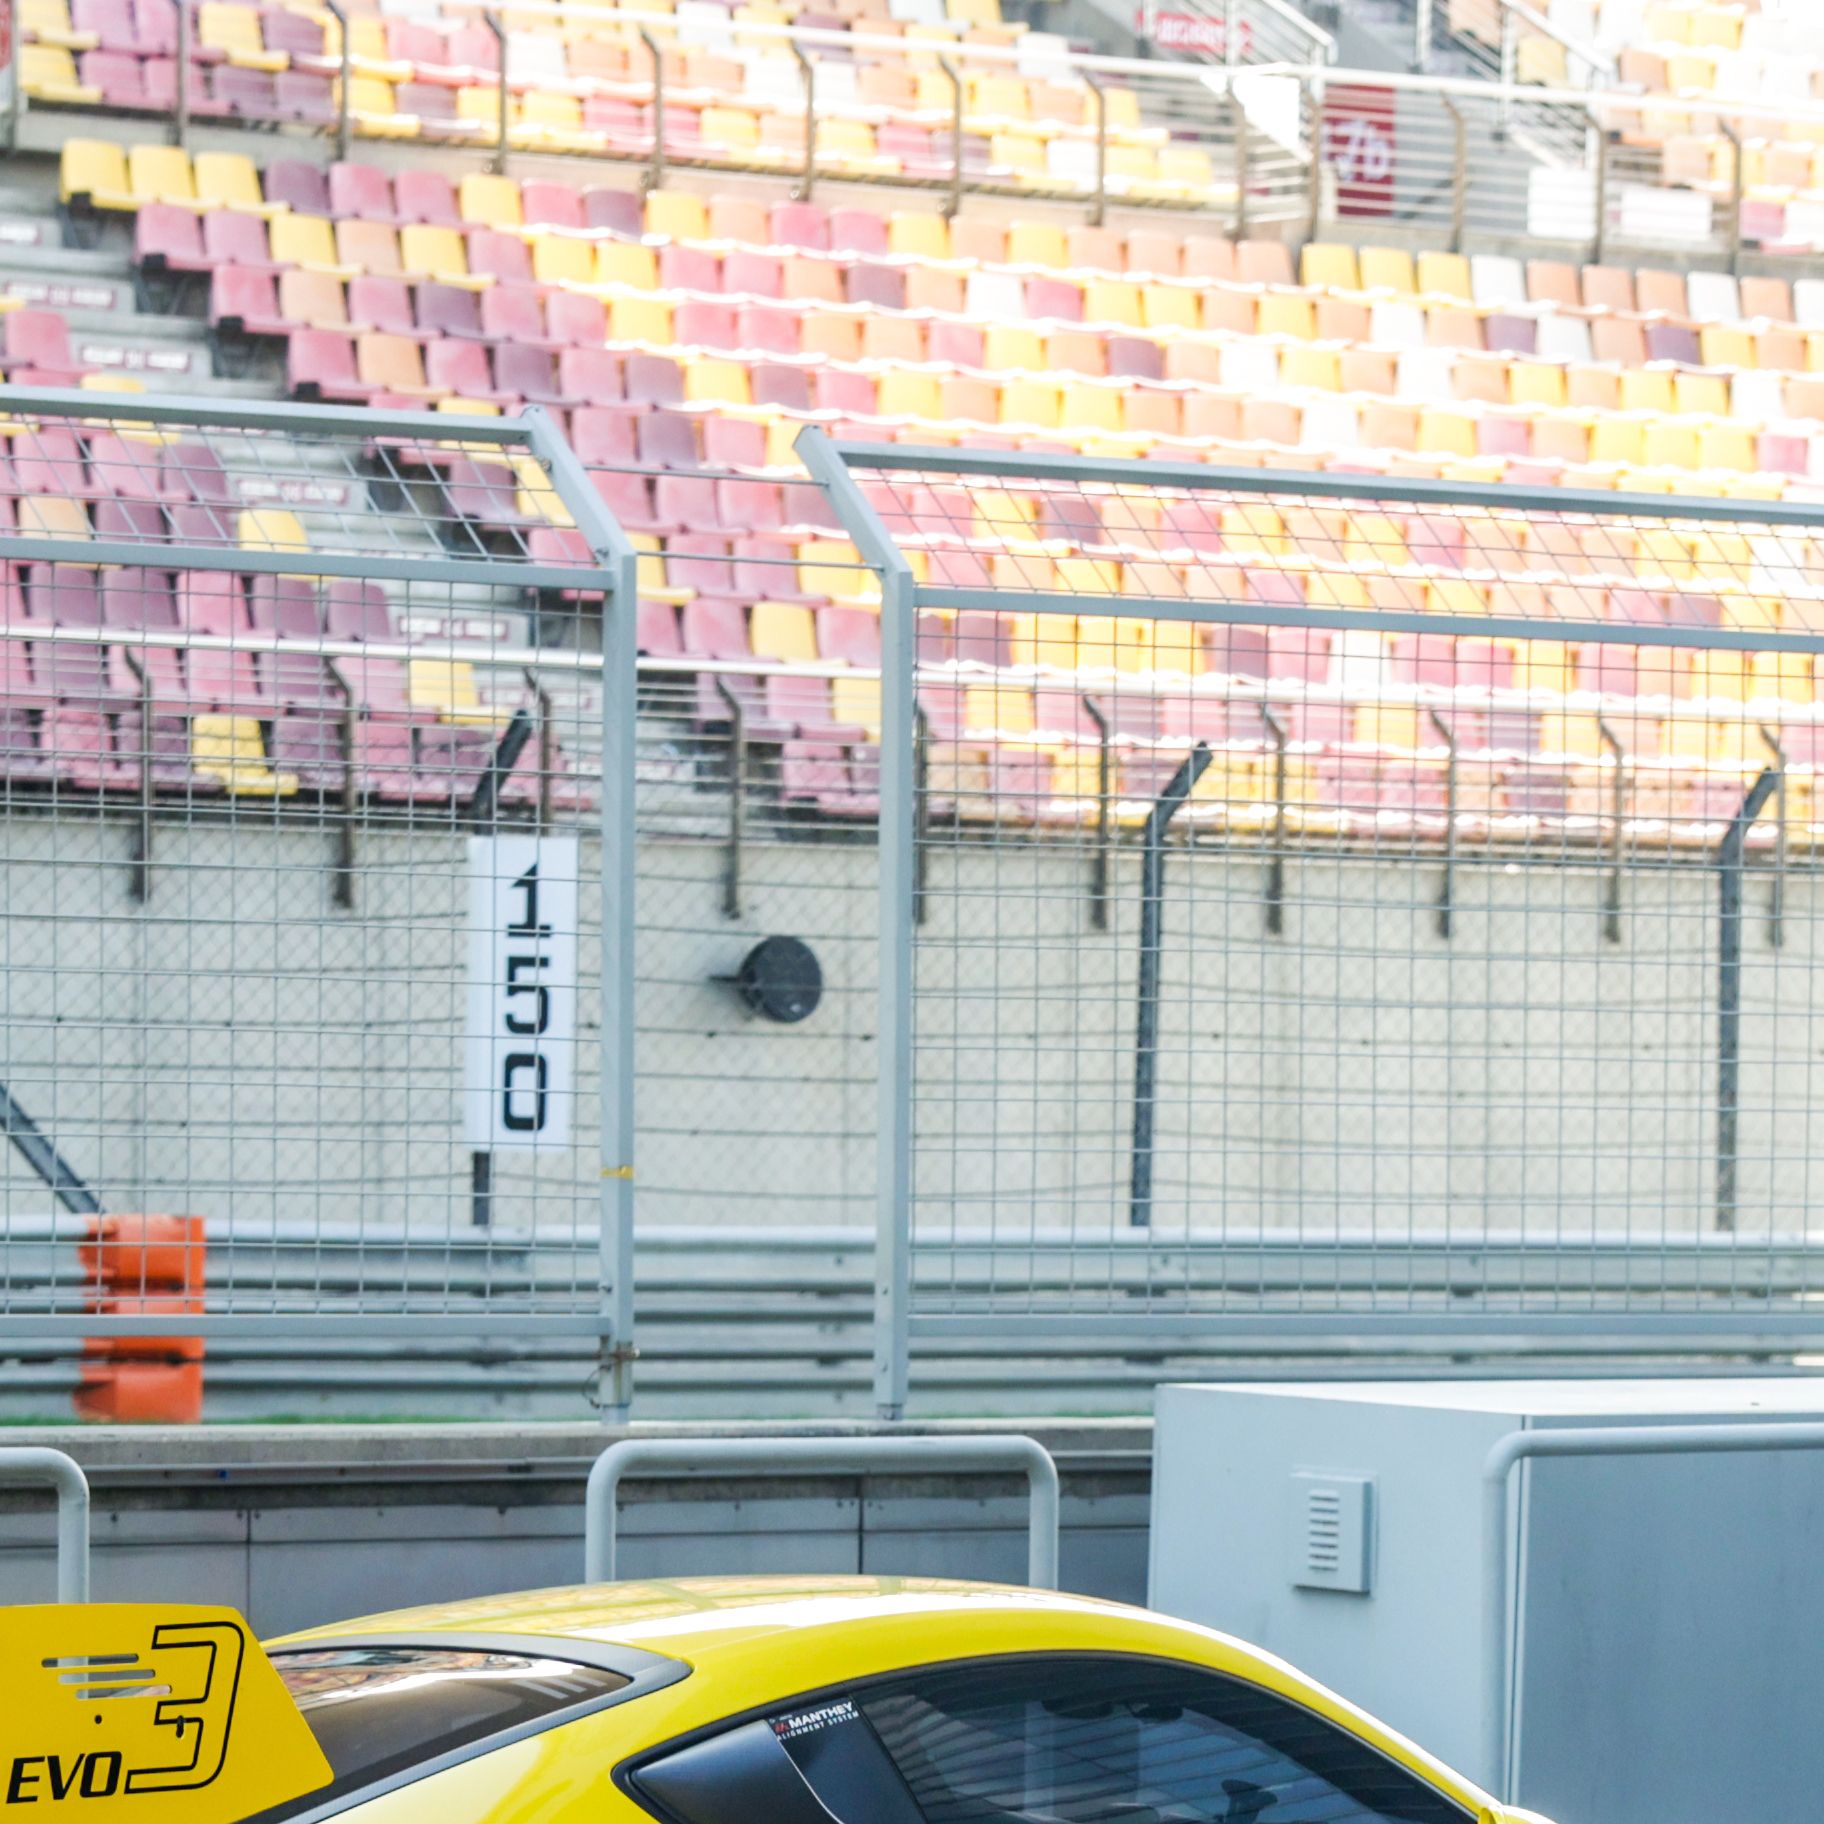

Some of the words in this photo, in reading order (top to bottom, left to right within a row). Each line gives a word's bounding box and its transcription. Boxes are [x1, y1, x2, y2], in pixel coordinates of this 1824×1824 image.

[504, 862, 552, 1131] 150
[6, 1751, 123, 1804] EVO
[124, 1621, 245, 1795] 3
[777, 1721, 824, 1740] ALIGNMENT
[828, 1711, 859, 1726] SYSTEM
[788, 1701, 852, 1728] MANTHEY
